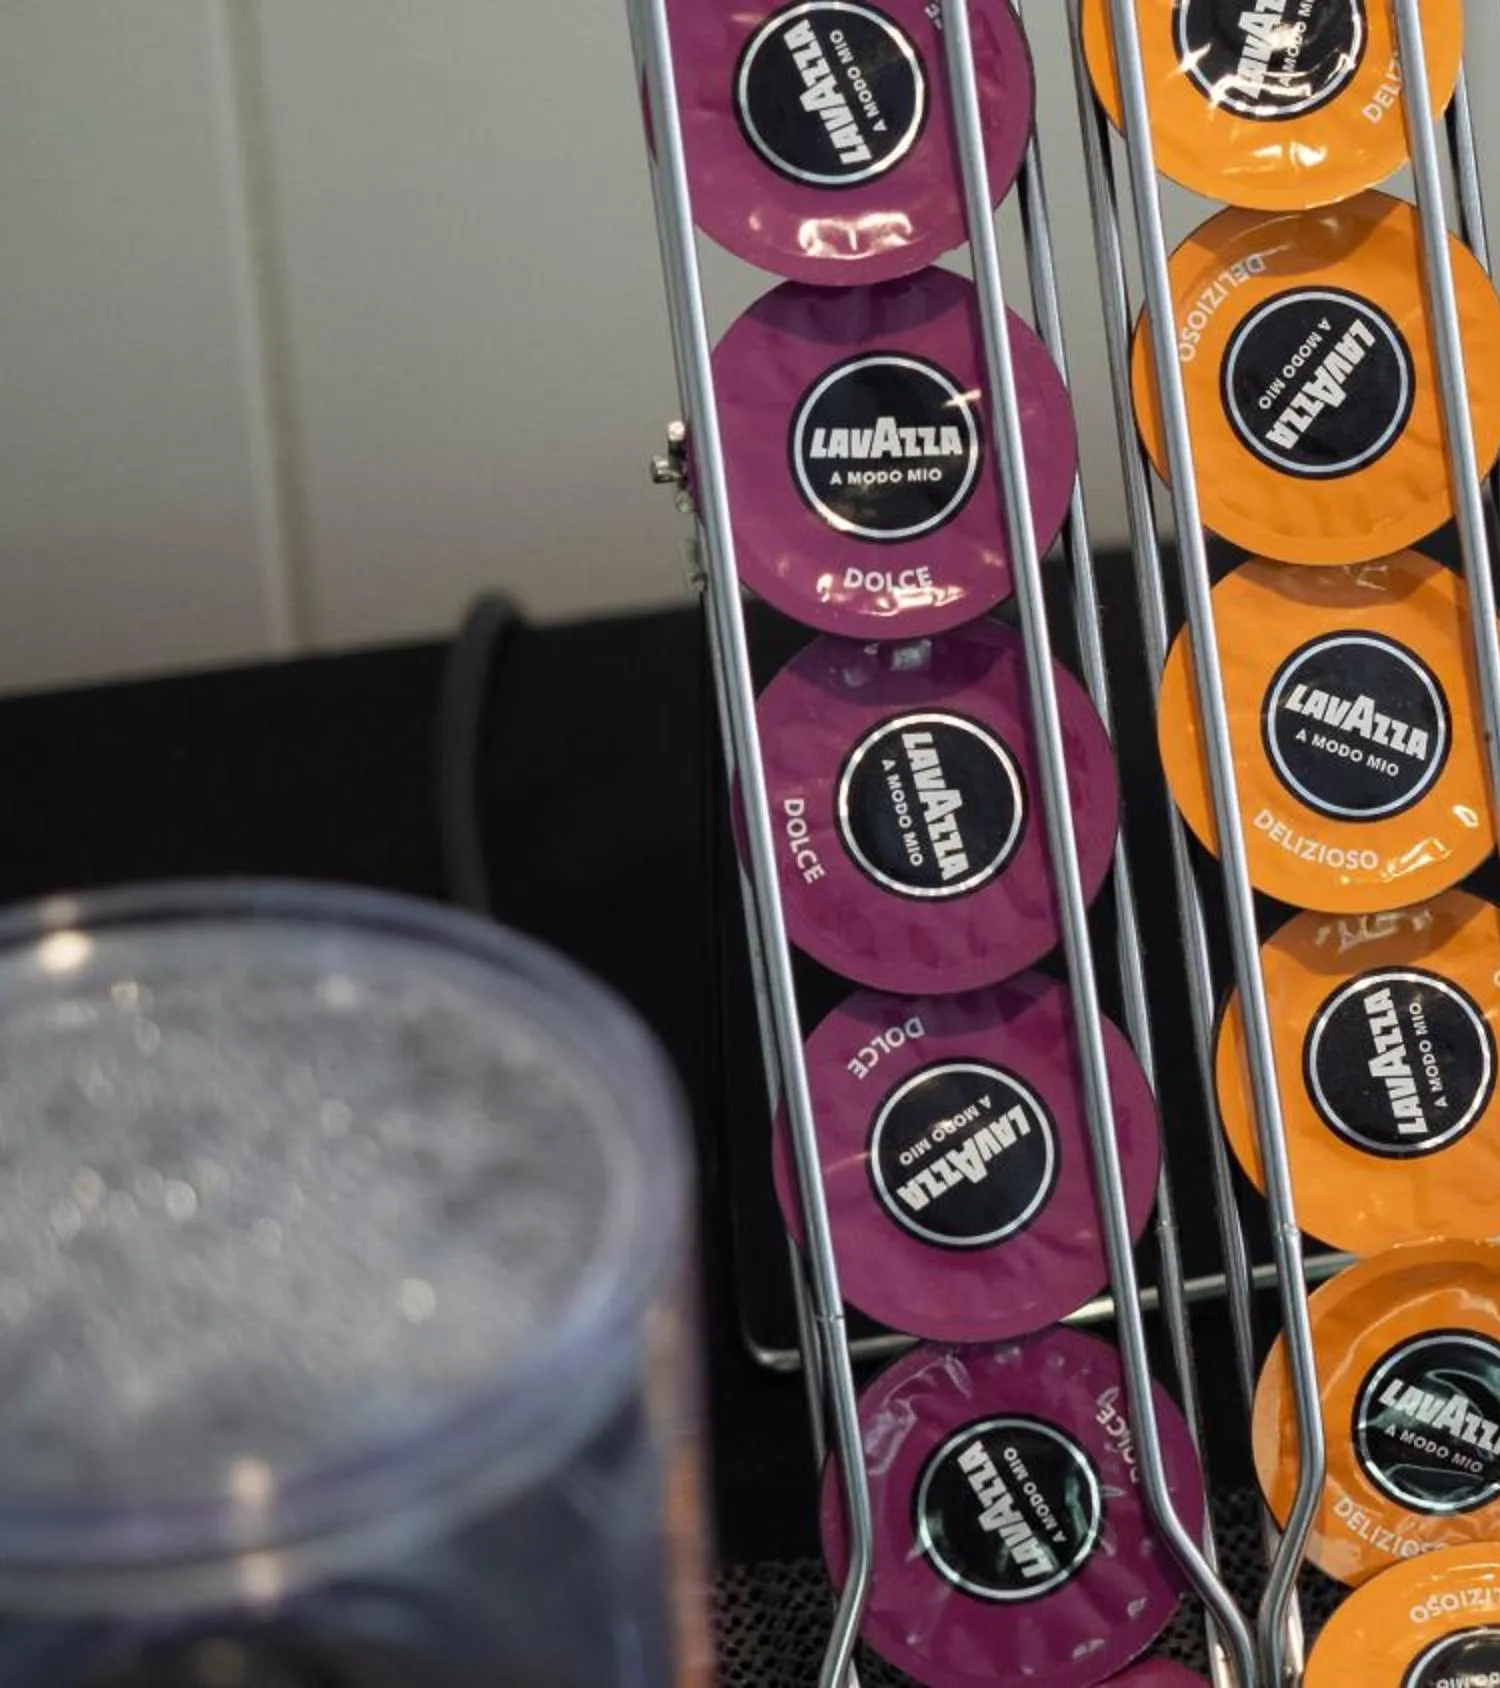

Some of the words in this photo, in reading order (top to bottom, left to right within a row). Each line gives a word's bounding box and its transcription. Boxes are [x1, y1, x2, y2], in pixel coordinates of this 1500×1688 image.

[829, 30, 854, 64] MIO
[1237, 0, 1286, 99] LAVAZ
[783, 19, 872, 164] LAVAZZA
[847, 66, 880, 118] MODO
[873, 119, 888, 132] A
[1180, 254, 1267, 363] DELIZIOSO
[1317, 317, 1331, 331] A
[1283, 331, 1322, 379] MODO
[1259, 376, 1286, 410] MIO
[1264, 319, 1376, 449] LAVAZZA
[809, 416, 963, 458] LAVAZZA
[829, 472, 842, 485] A
[848, 470, 902, 485] MODO
[907, 468, 944, 482] MIO
[843, 566, 933, 593] DOLCE
[1285, 683, 1429, 760] LAVAZZA
[881, 759, 893, 771] A
[1296, 729, 1307, 742] A
[1312, 733, 1363, 762] MODO
[1367, 755, 1399, 777] MIO
[886, 775, 912, 829] MODO
[902, 732, 968, 880] LAVAZZA
[784, 798, 826, 884] DOLCE
[902, 831, 923, 867] MIO
[1253, 808, 1378, 870] DELIZIOSO
[1409, 1002, 1429, 1036] MIO
[847, 1017, 925, 1079] DOLCE
[1363, 987, 1428, 1134] LAVAZZA
[1419, 1039, 1443, 1092] MODO
[931, 1104, 980, 1142] MODO
[979, 1095, 992, 1109] A
[1434, 1096, 1448, 1108] A
[896, 1104, 1031, 1212] LAVAZZA
[900, 1138, 932, 1165] MIO
[1003, 1447, 1029, 1481] MIO
[1384, 1424, 1396, 1437] A
[1400, 1428, 1448, 1459] MODO
[1451, 1452, 1484, 1473] MIO
[957, 1440, 1054, 1578] LAVAZZA
[1023, 1481, 1058, 1533] MODO
[1053, 1531, 1068, 1543] A
